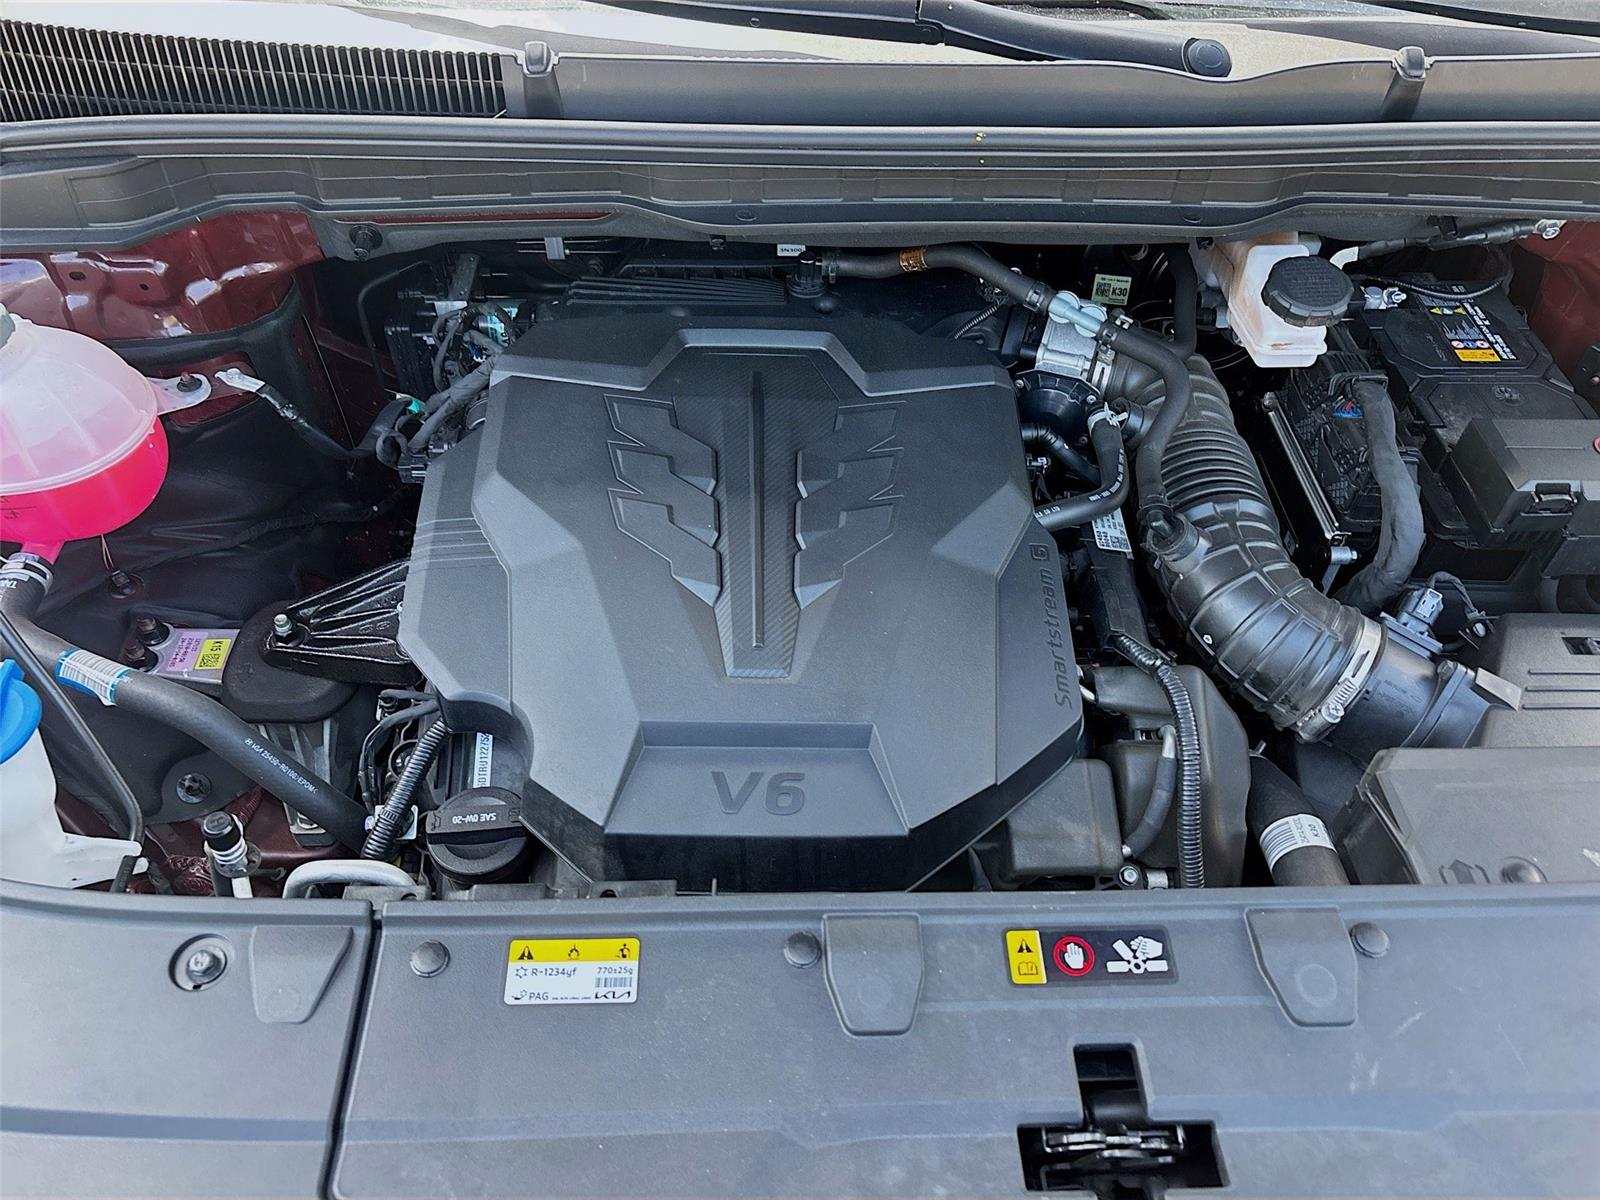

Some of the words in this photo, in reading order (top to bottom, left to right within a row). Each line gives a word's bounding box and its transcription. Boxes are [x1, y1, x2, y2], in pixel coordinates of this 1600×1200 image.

[1111, 286, 1128, 297] K30
[1040, 568, 1073, 710] Smartstream
[210, 640, 224, 652] K15
[710, 771, 806, 816] V6
[452, 814, 479, 824] 0W-20
[480, 812, 497, 821] SAE
[1308, 823, 1320, 838] K30
[531, 966, 577, 978] R-1234yf
[528, 992, 549, 1001] PAG
